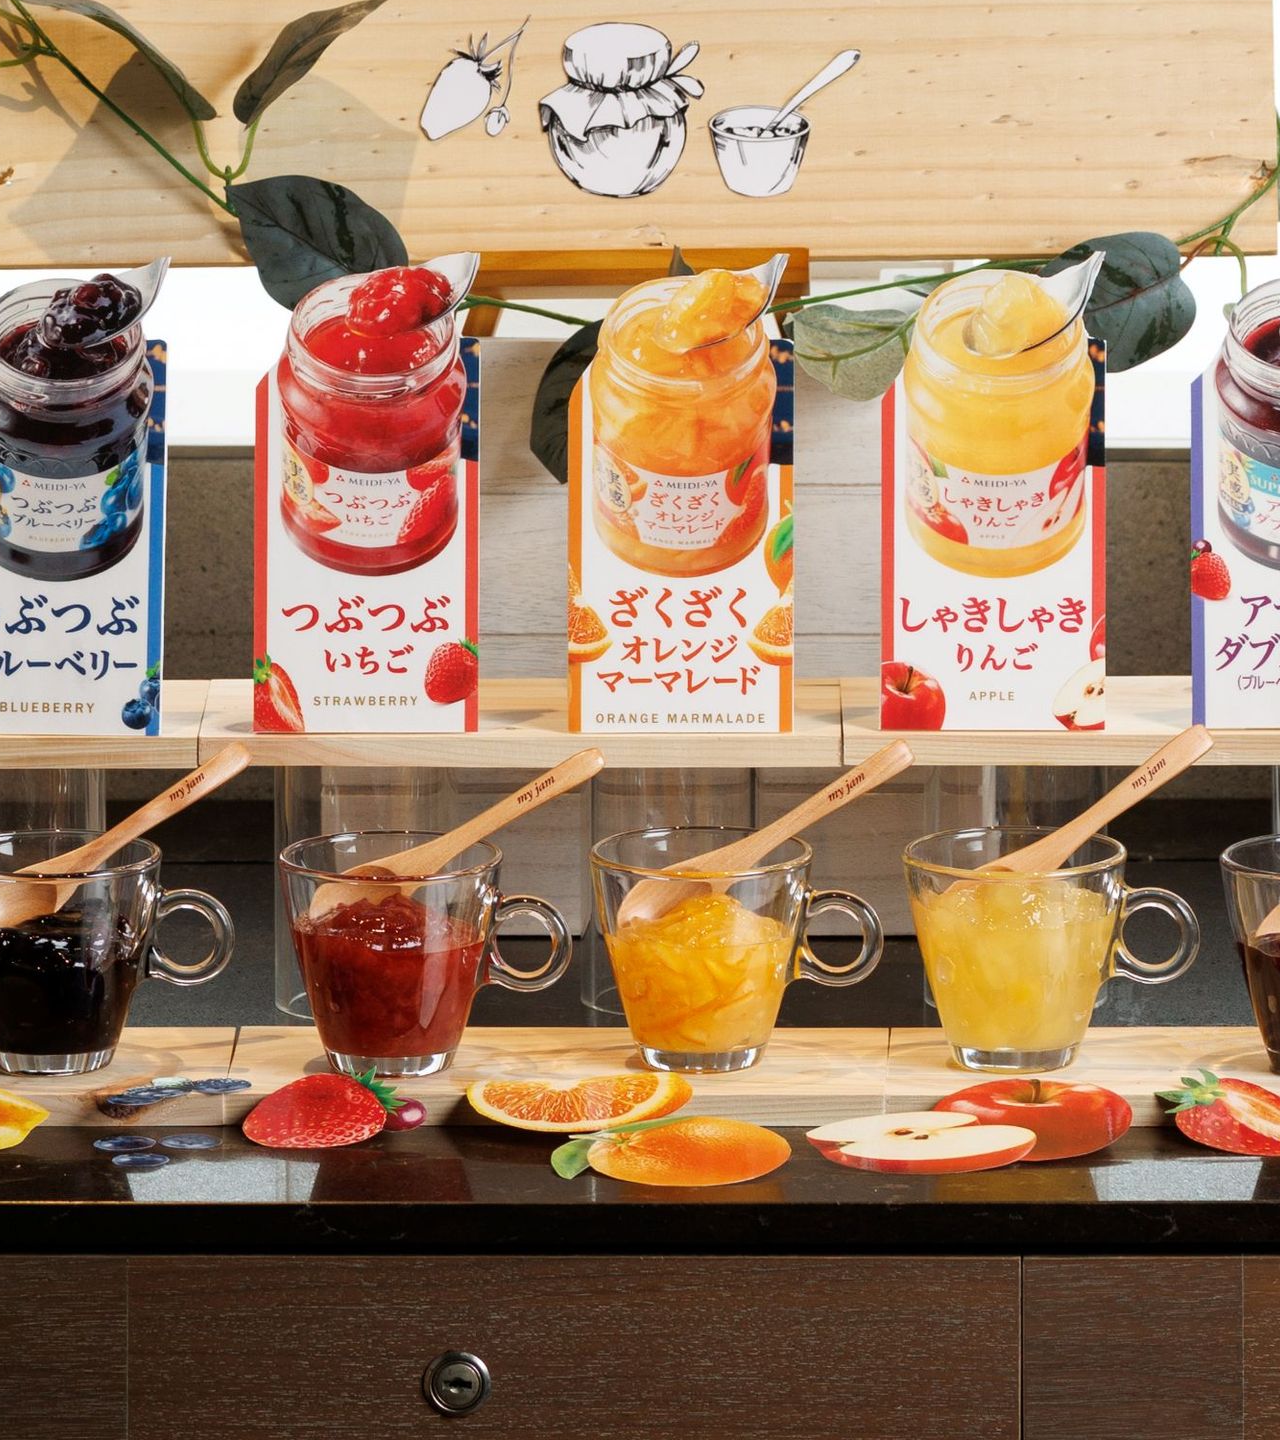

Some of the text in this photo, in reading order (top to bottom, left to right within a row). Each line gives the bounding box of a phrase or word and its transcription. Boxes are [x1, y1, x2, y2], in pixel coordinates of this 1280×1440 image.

[349, 478, 401, 487] MEIDI-YA
[324, 491, 412, 510] つぶつぶ
[346, 513, 392, 526] いちご
[281, 595, 451, 634] つぶつぶ
[608, 586, 747, 629] ざくざく
[899, 596, 1087, 634] しゃきしゃき
[323, 644, 415, 676] いちご
[620, 634, 738, 665] オレンジ
[956, 642, 1039, 673] りんご
[596, 665, 761, 696] マーマレード
[0, 701, 95, 714] BLUEBERRY
[313, 695, 418, 707] STRAWBERRY
[969, 690, 1015, 702] APPLE
[595, 712, 765, 724] ORANGE MARMALADE
